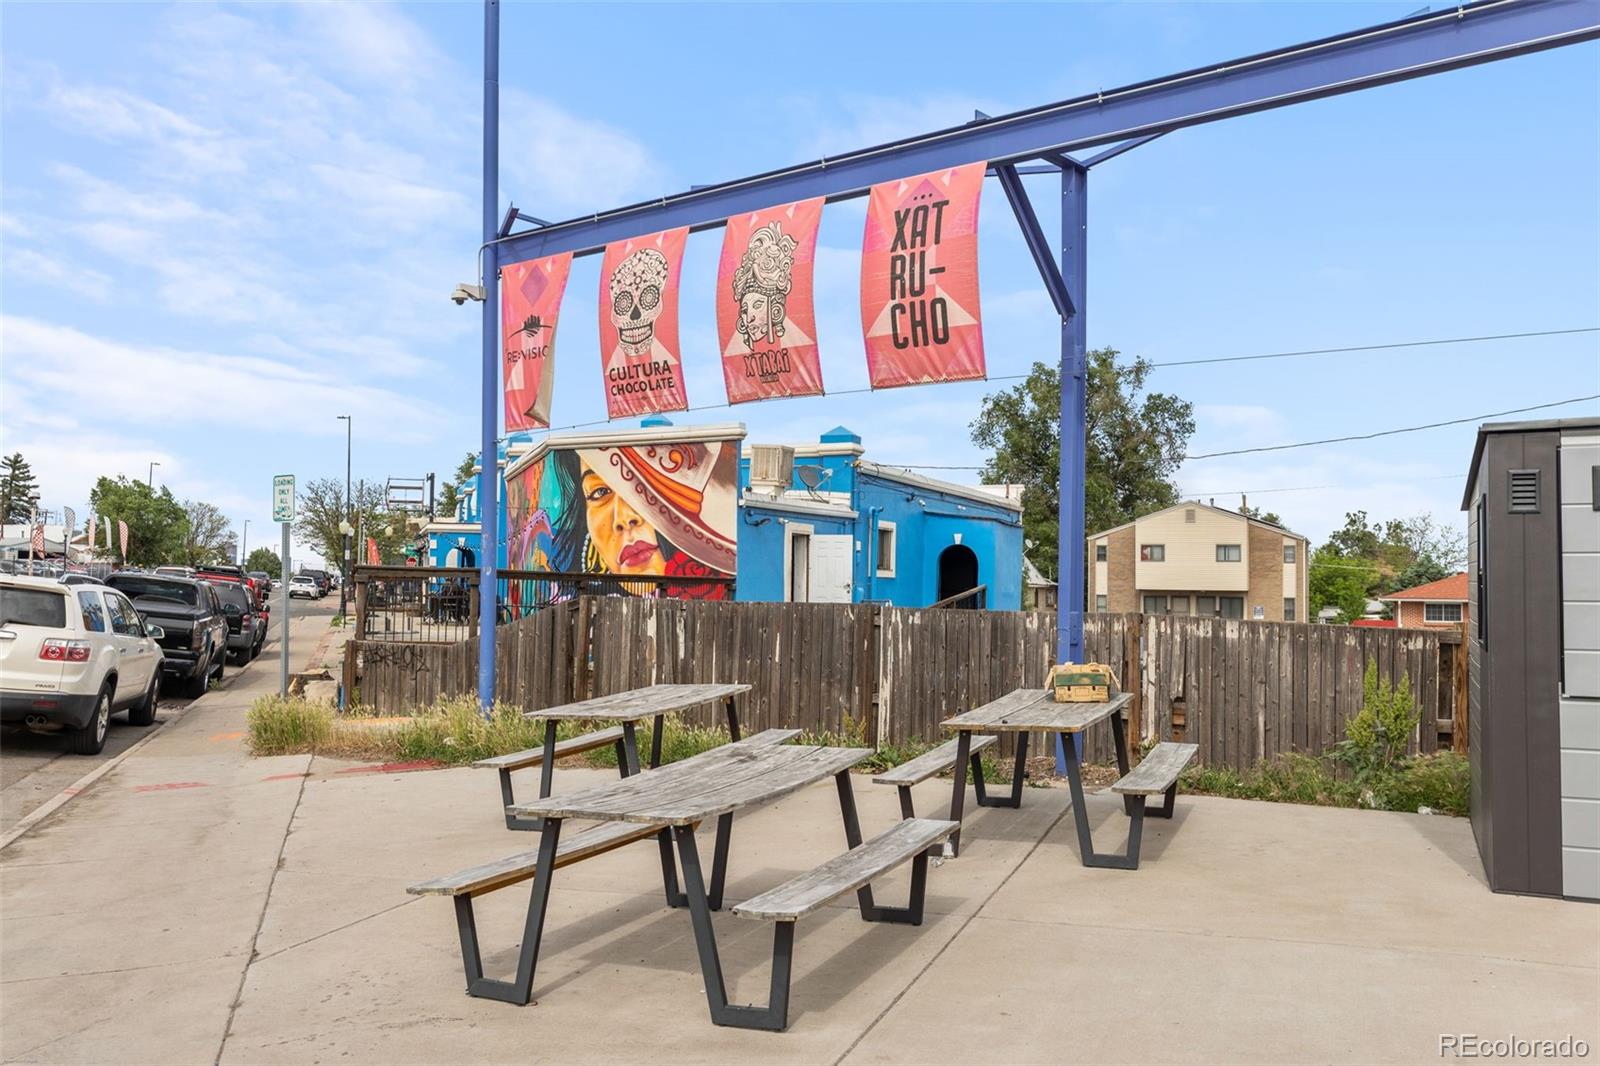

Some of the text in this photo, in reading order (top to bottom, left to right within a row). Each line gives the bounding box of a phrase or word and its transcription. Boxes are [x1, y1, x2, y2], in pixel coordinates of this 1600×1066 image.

[890, 200, 950, 253] XAT
[890, 250, 946, 300] RU-
[890, 297, 950, 349] CHO
[609, 360, 672, 382] CULTURA
[610, 377, 675, 396] CHOCOLATE
